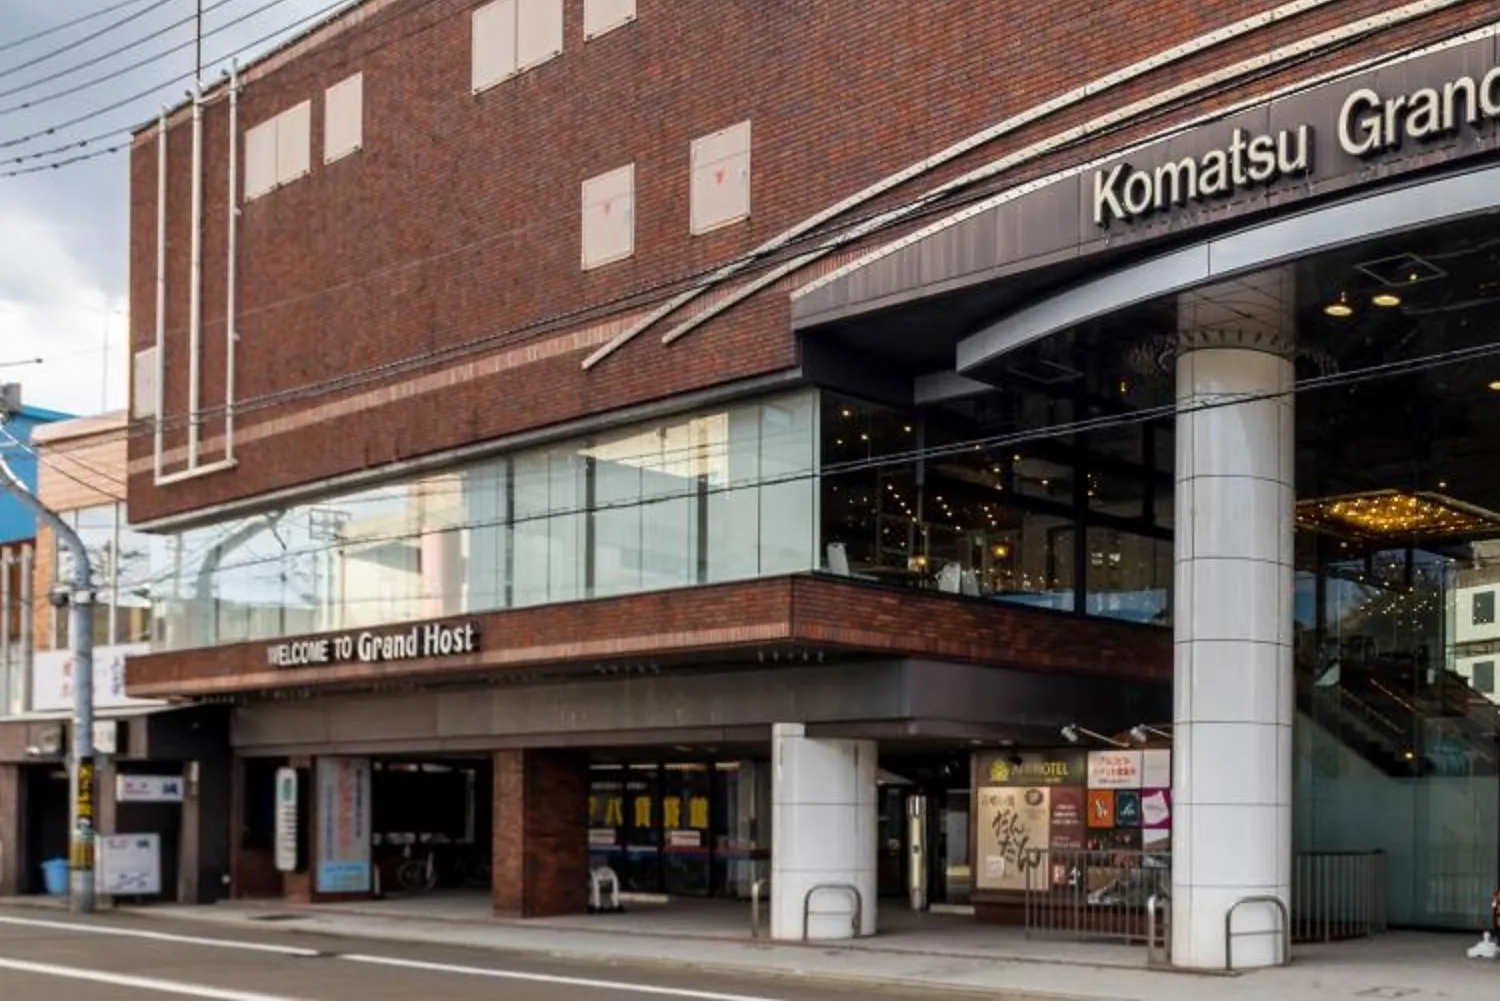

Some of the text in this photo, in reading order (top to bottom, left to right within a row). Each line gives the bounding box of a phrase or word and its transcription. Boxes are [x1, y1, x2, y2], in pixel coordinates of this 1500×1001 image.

[1094, 125, 1308, 223] Komatsu
[267, 623, 474, 666] WELCOME TO Grand Host
